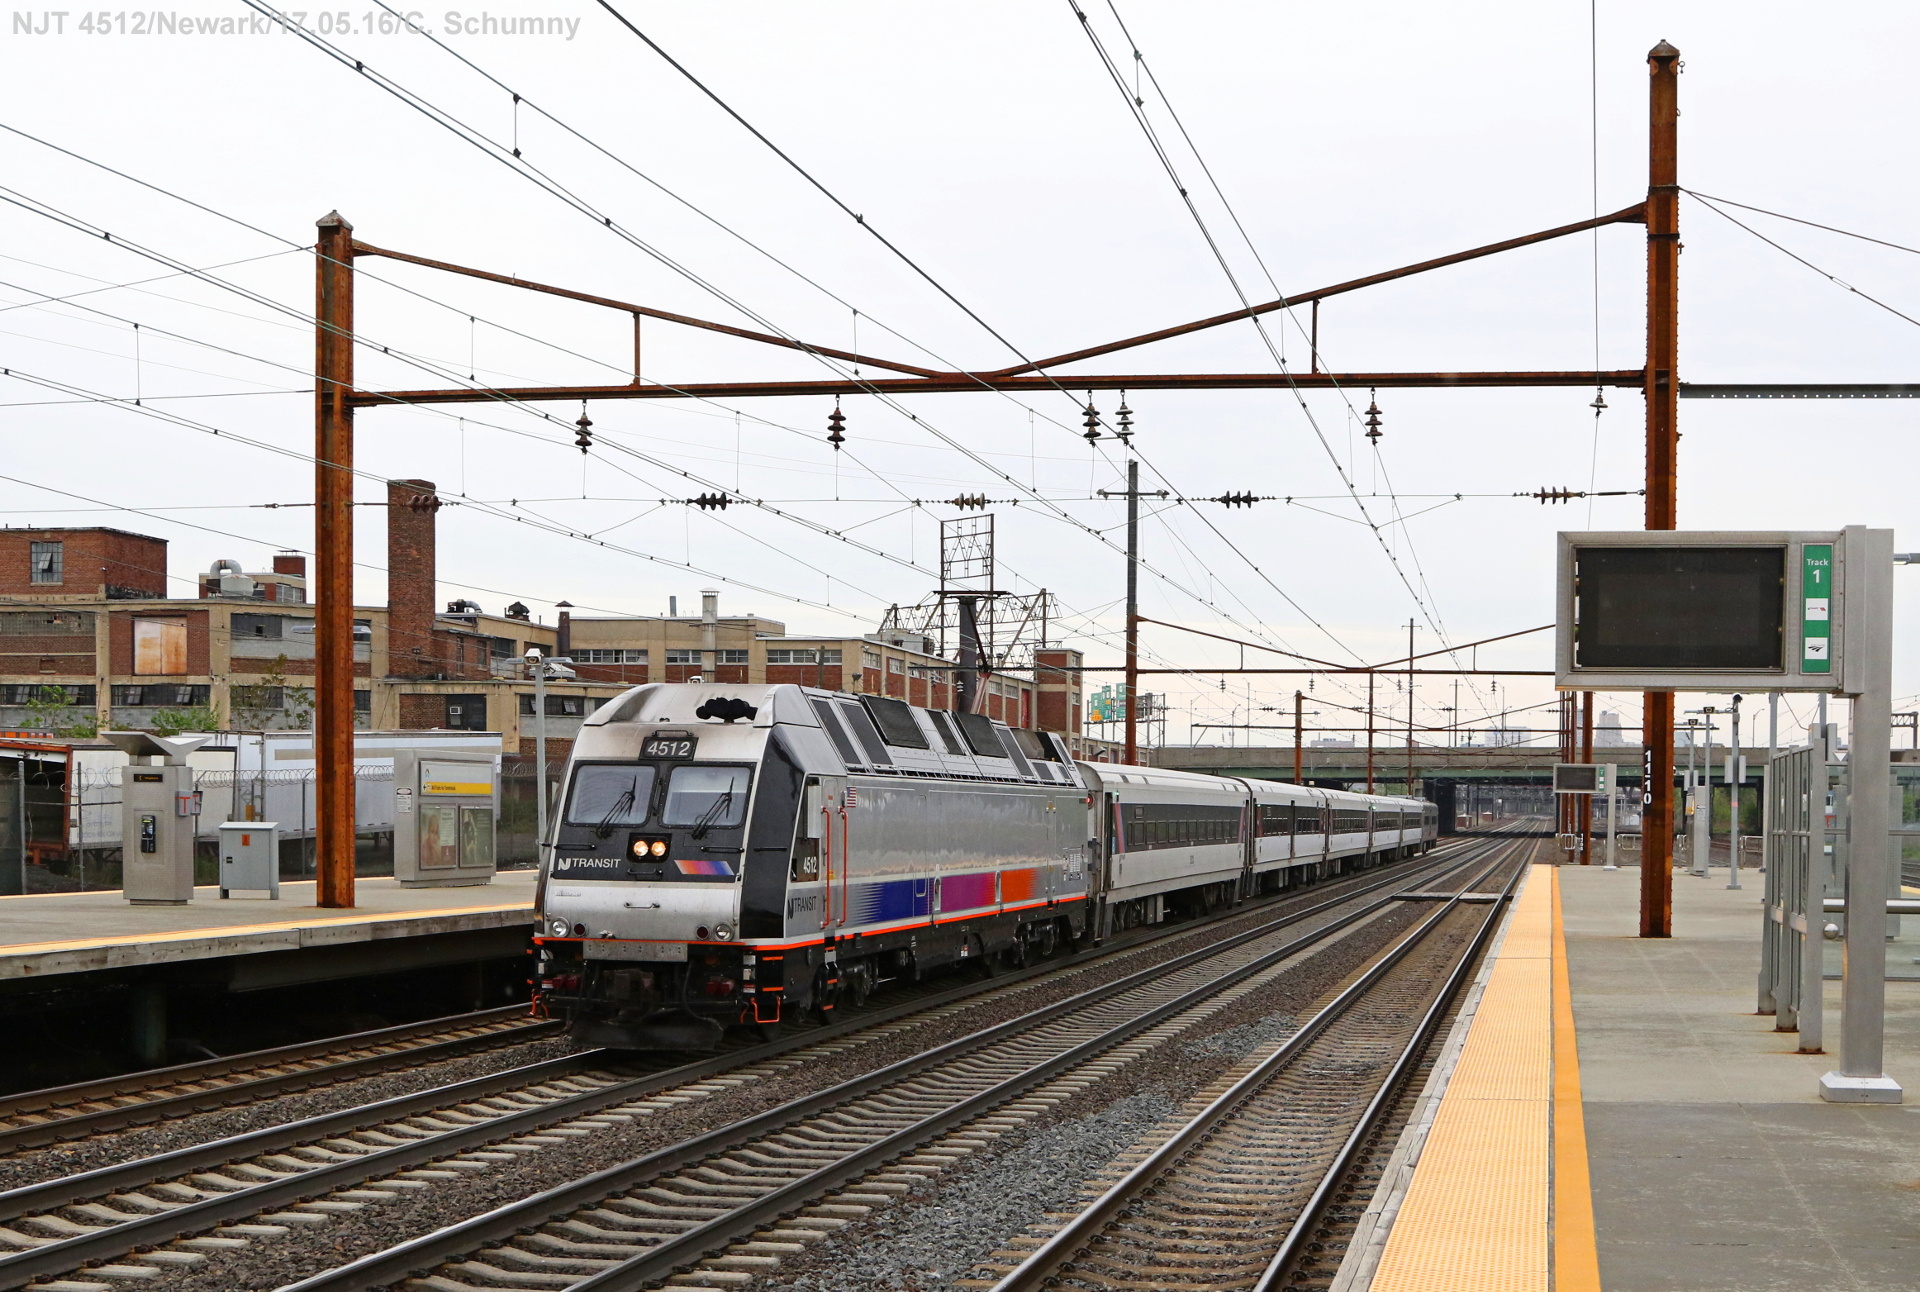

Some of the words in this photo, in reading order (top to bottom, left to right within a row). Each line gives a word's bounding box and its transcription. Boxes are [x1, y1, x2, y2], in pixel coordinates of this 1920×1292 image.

[1806, 558, 1829, 566] Track
[1812, 569, 1821, 584] 1
[647, 741, 691, 756] 4512
[1643, 750, 1652, 805] 11-10
[572, 858, 621, 869] TRANSIT
[803, 856, 817, 874] 4512
[794, 896, 816, 914] TRANSIT
